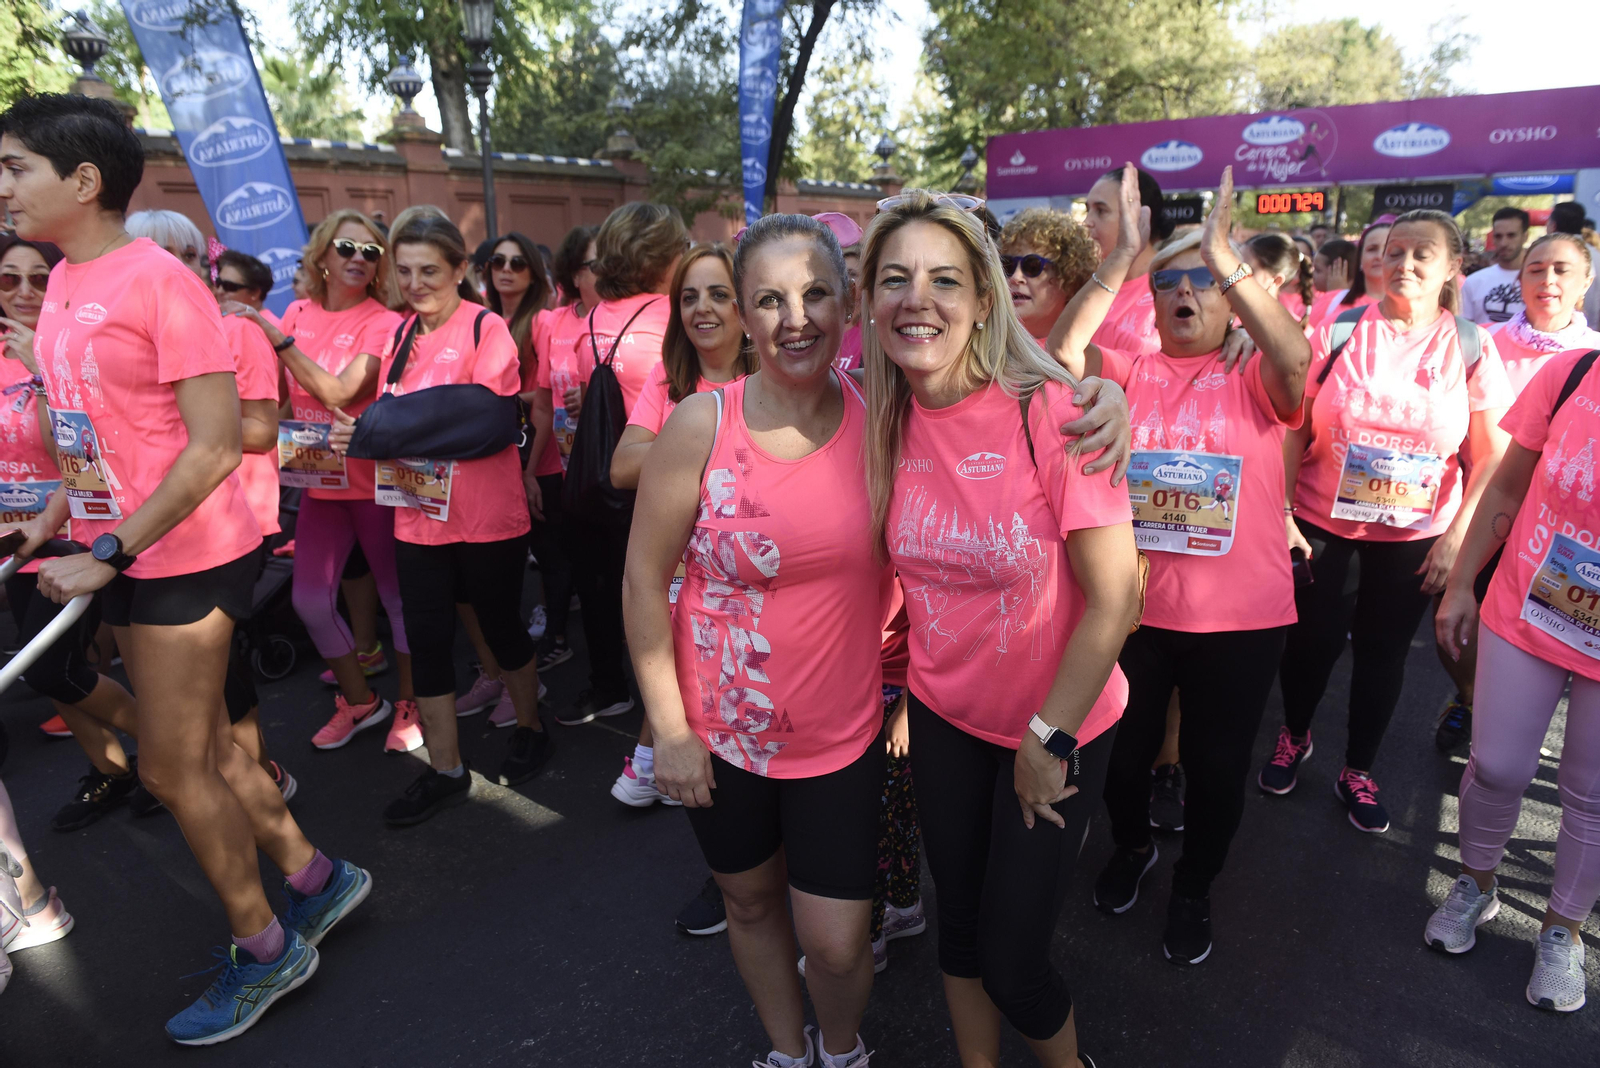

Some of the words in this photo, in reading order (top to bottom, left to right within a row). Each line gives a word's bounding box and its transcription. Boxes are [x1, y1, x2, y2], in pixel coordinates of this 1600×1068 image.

[1489, 125, 1558, 144] OYSHO
[1380, 136, 1444, 149] ASTURIANA
[997, 163, 1038, 177] Santander
[1064, 156, 1112, 171] OYSHO
[1264, 159, 1306, 182] Mujer
[1385, 192, 1444, 208] OYSHO
[1164, 206, 1194, 219] SHO
[296, 407, 334, 422] DORS
[1328, 427, 1351, 441] TU
[1358, 432, 1438, 454] DORSAL
[295, 448, 322, 461] 016
[0, 460, 42, 474] RSAL
[960, 463, 1004, 474] ASTURIANA
[1155, 468, 1203, 481] ASTURIANA
[396, 466, 425, 485] 016
[1368, 478, 1408, 496] 016
[1152, 490, 1201, 511] 016
[1162, 513, 1186, 522] 4140
[1538, 503, 1557, 527] TU
[1140, 521, 1166, 530] CARRERA
[1186, 526, 1208, 534] MUJER
[1134, 534, 1160, 544] YSHO
[1530, 608, 1566, 633] OYSHO
[1549, 605, 1575, 624] CARRERA
[1576, 621, 1584, 629] DE
[1585, 626, 1594, 634] LA
[1573, 609, 1599, 626] 5341
